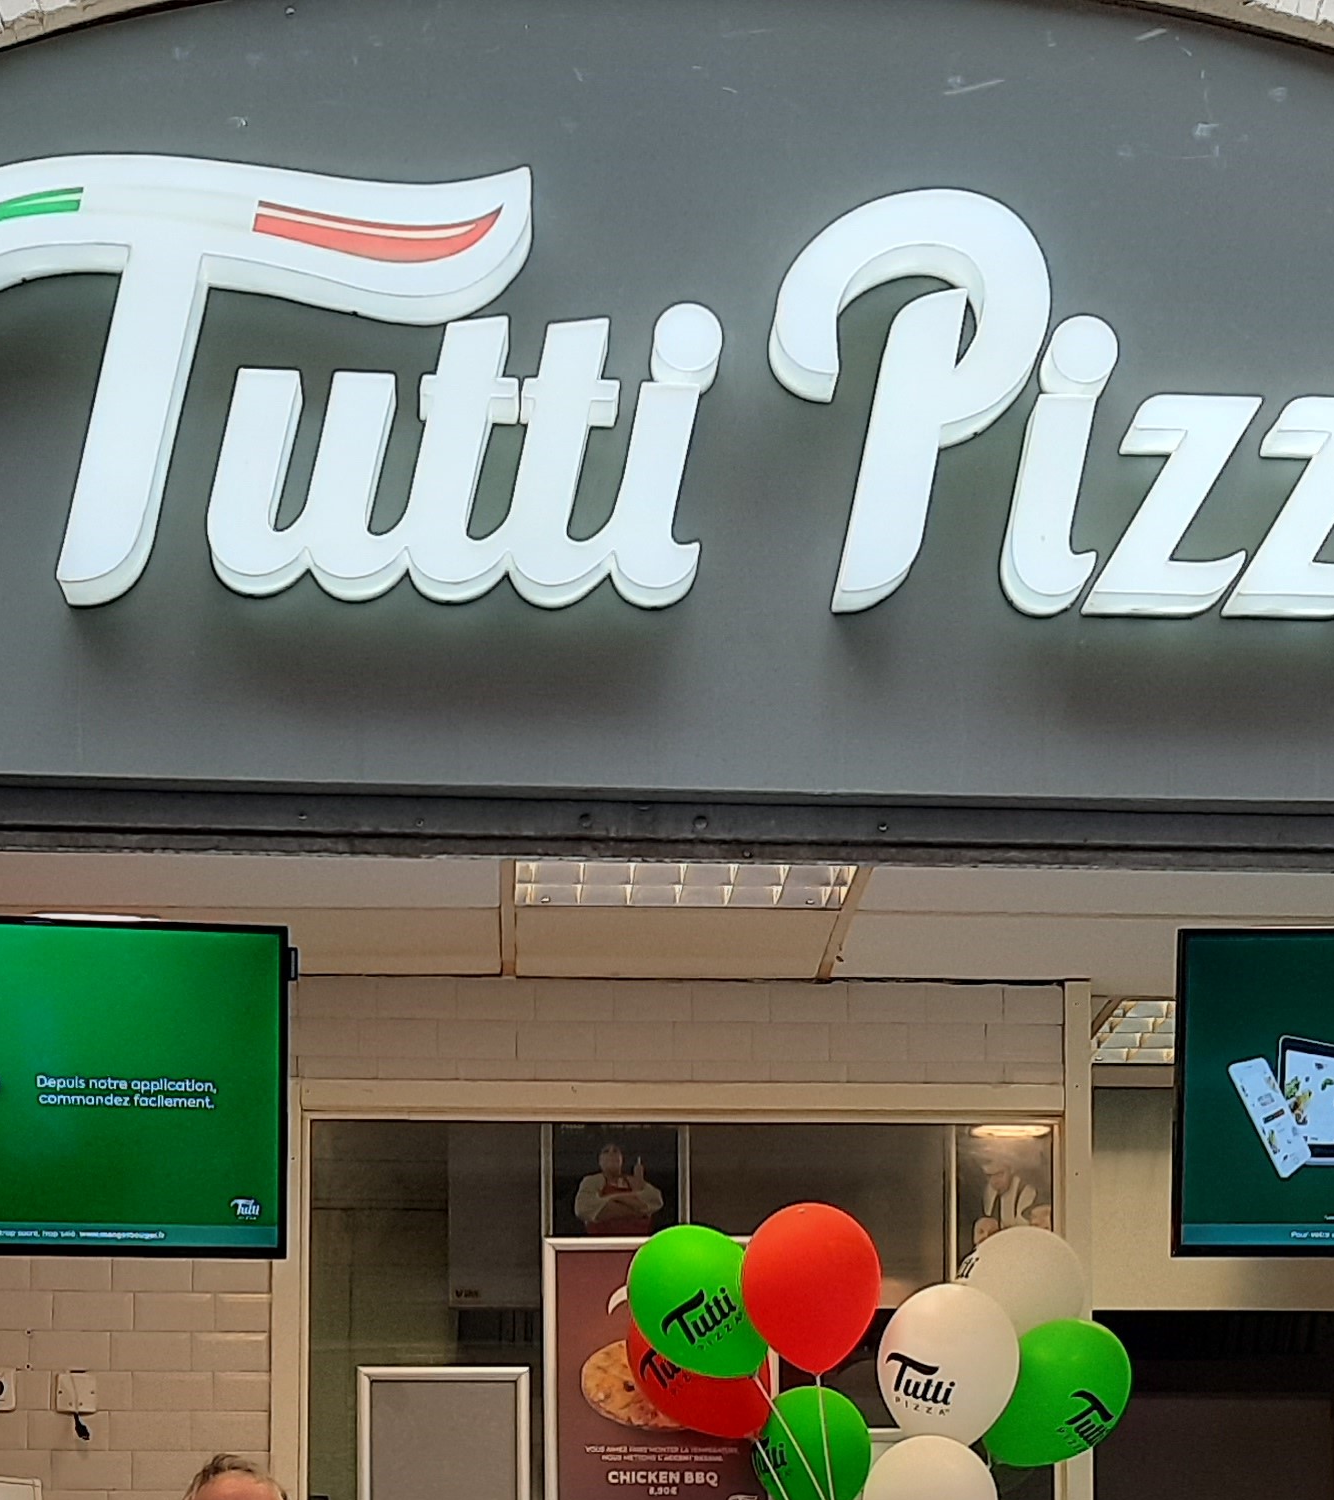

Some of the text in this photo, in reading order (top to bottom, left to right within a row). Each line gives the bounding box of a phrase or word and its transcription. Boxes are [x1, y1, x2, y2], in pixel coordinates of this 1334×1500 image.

[36, 1075, 216, 1094] Depuis notre application,
[39, 1094, 214, 1109] commandez facilement.
[661, 1287, 738, 1345] Tutti
[886, 1353, 955, 1405] Tutti
[608, 1471, 718, 1487] CHICKEN BBQ
